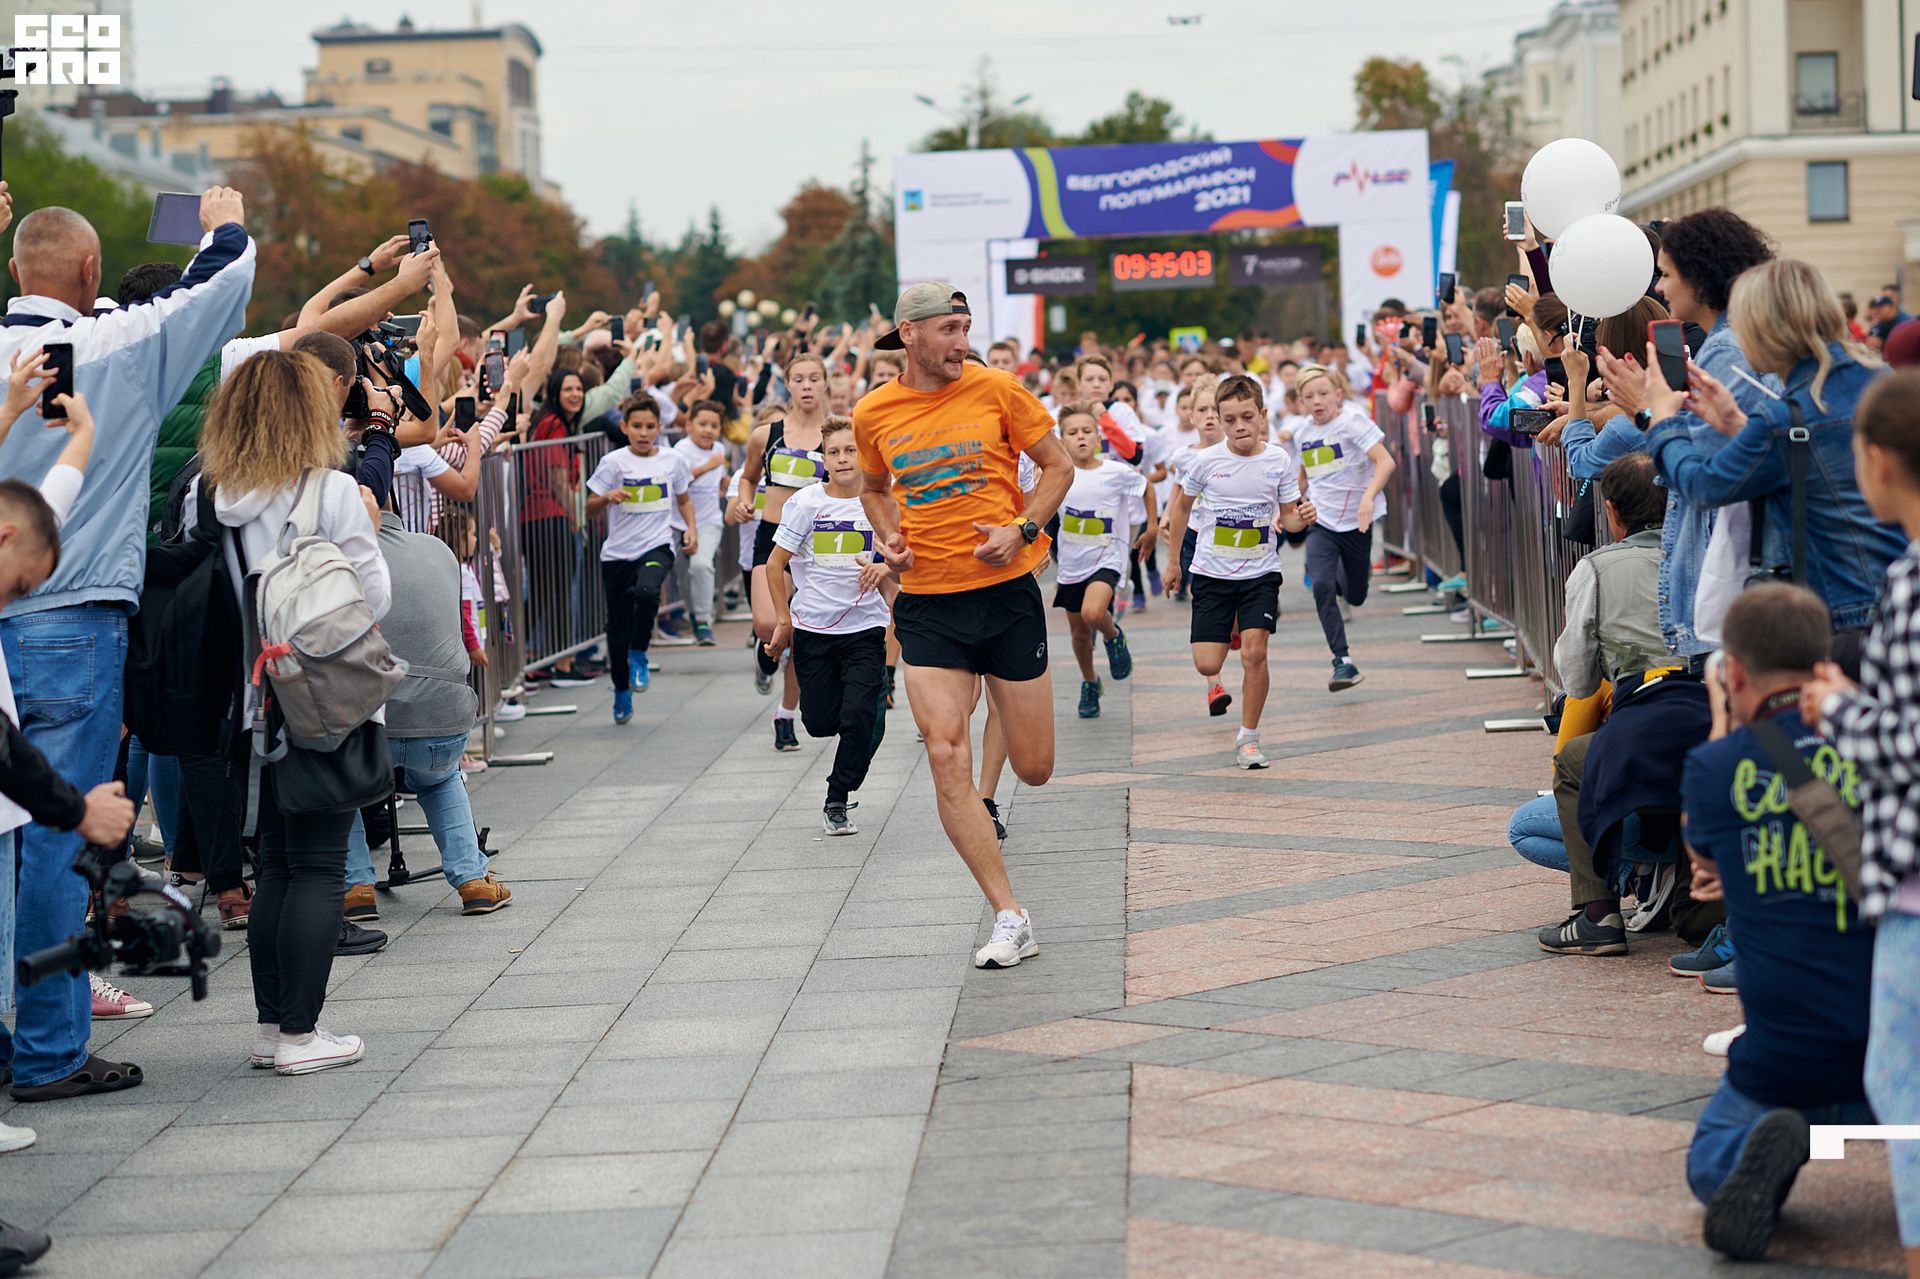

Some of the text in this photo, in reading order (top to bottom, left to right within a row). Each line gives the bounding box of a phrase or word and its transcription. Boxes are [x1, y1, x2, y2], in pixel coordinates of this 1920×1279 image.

[1066, 146, 1233, 191] БЕЛГОРОДСКИЙ
[1099, 167, 1256, 211] ПОЛУМАРАФОН
[1194, 185, 1251, 213] 2021
[1114, 250, 1212, 280] 09:35:03
[371, 411, 395, 427] Canon
[946, 439, 983, 457] SWIM
[1311, 449, 1320, 465] 1
[787, 458, 798, 475] 1
[957, 457, 984, 476] BIKE
[965, 475, 988, 493] RUN
[636, 487, 645, 503] 1
[1077, 519, 1086, 535] 1
[834, 532, 844, 553] 1
[1232, 529, 1243, 547] 1
